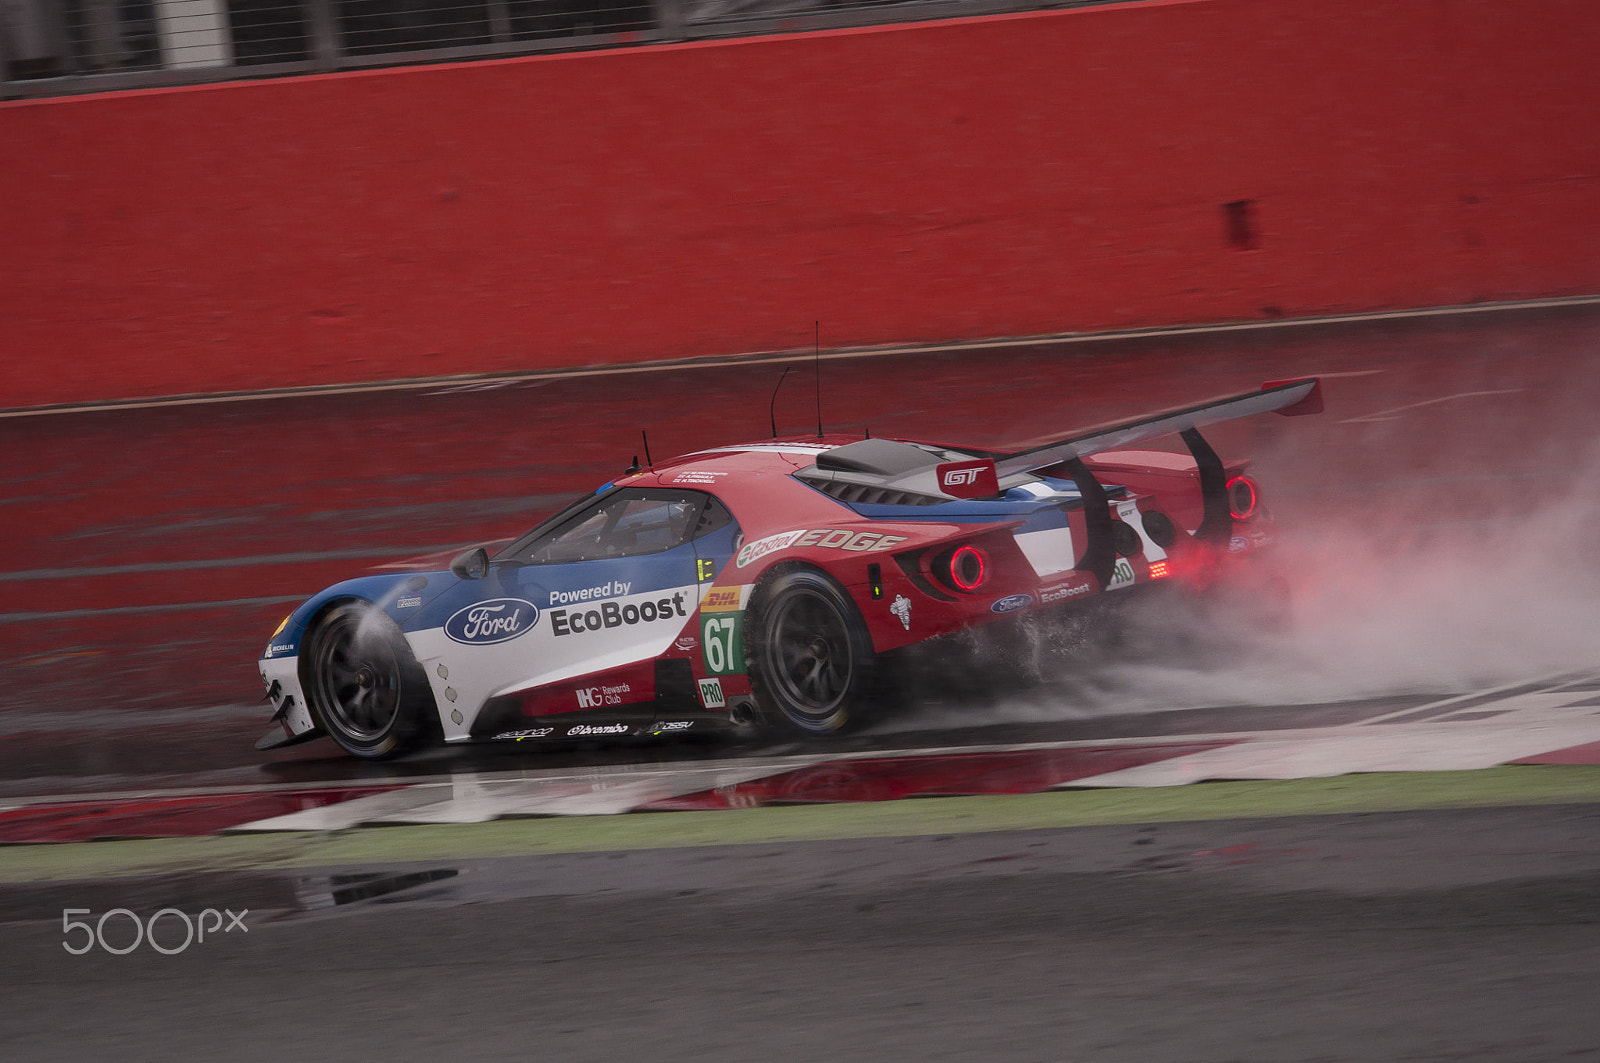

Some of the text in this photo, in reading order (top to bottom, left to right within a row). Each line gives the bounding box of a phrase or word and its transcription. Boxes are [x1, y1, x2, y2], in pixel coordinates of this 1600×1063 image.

[944, 466, 988, 486] GT
[1121, 508, 1136, 517] GT
[749, 529, 909, 559] Castrol EDGE
[1113, 562, 1133, 583] RO
[549, 581, 631, 605] Powered by
[707, 592, 736, 606] DHL
[1041, 583, 1090, 603] EcoBoost
[550, 591, 687, 637] EcoBoost
[999, 597, 1025, 612] Ford
[463, 604, 520, 639] Ford
[704, 617, 735, 673] 67
[575, 683, 631, 708] IHG Rewards
[604, 692, 622, 704] Club
[700, 683, 723, 703] PRO
[583, 722, 629, 735] brembo
